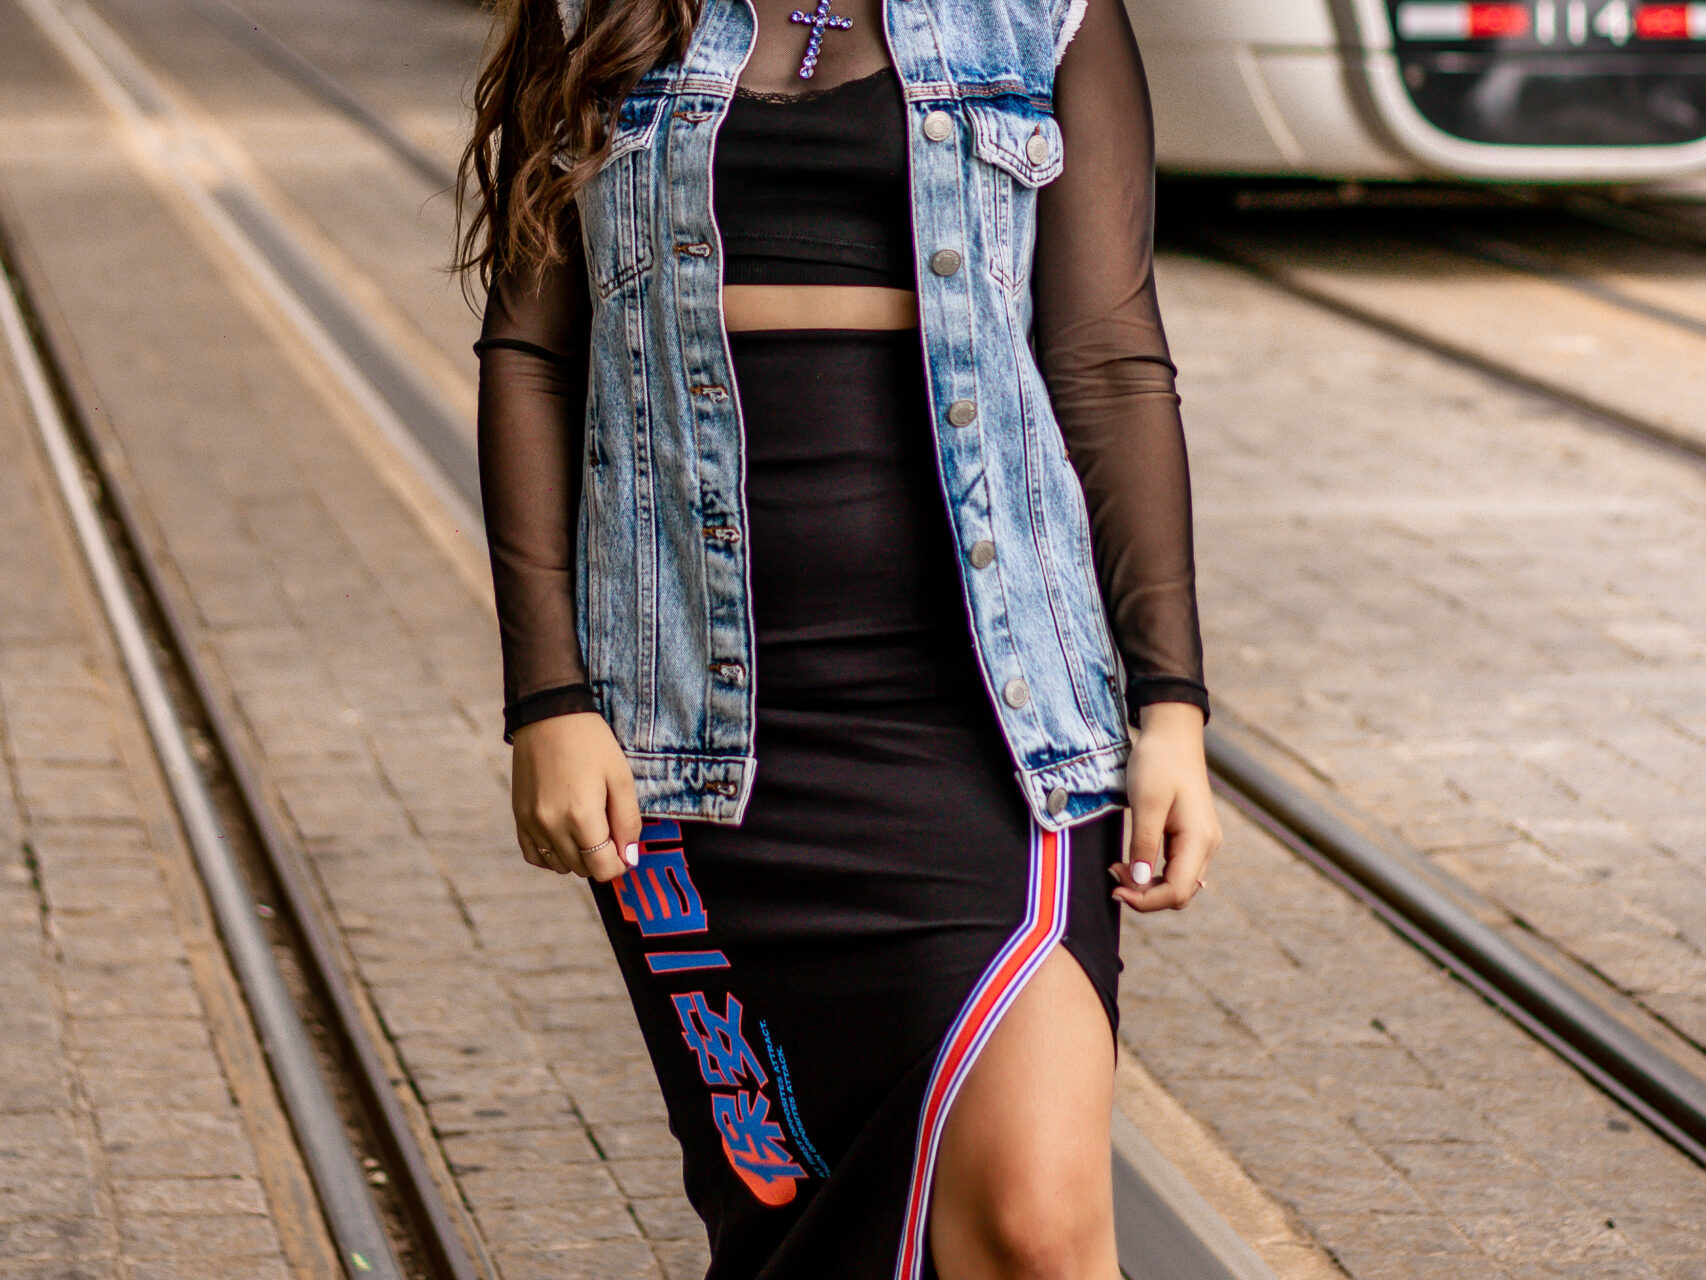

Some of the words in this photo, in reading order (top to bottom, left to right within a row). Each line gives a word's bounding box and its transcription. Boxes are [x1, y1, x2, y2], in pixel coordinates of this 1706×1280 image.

[759, 1019, 781, 1074] ATTRACT.
[777, 1075, 799, 1137] OPPOSITES
[788, 1096, 816, 1153] OPPOSITES
[795, 1138, 816, 1165] FIRST
